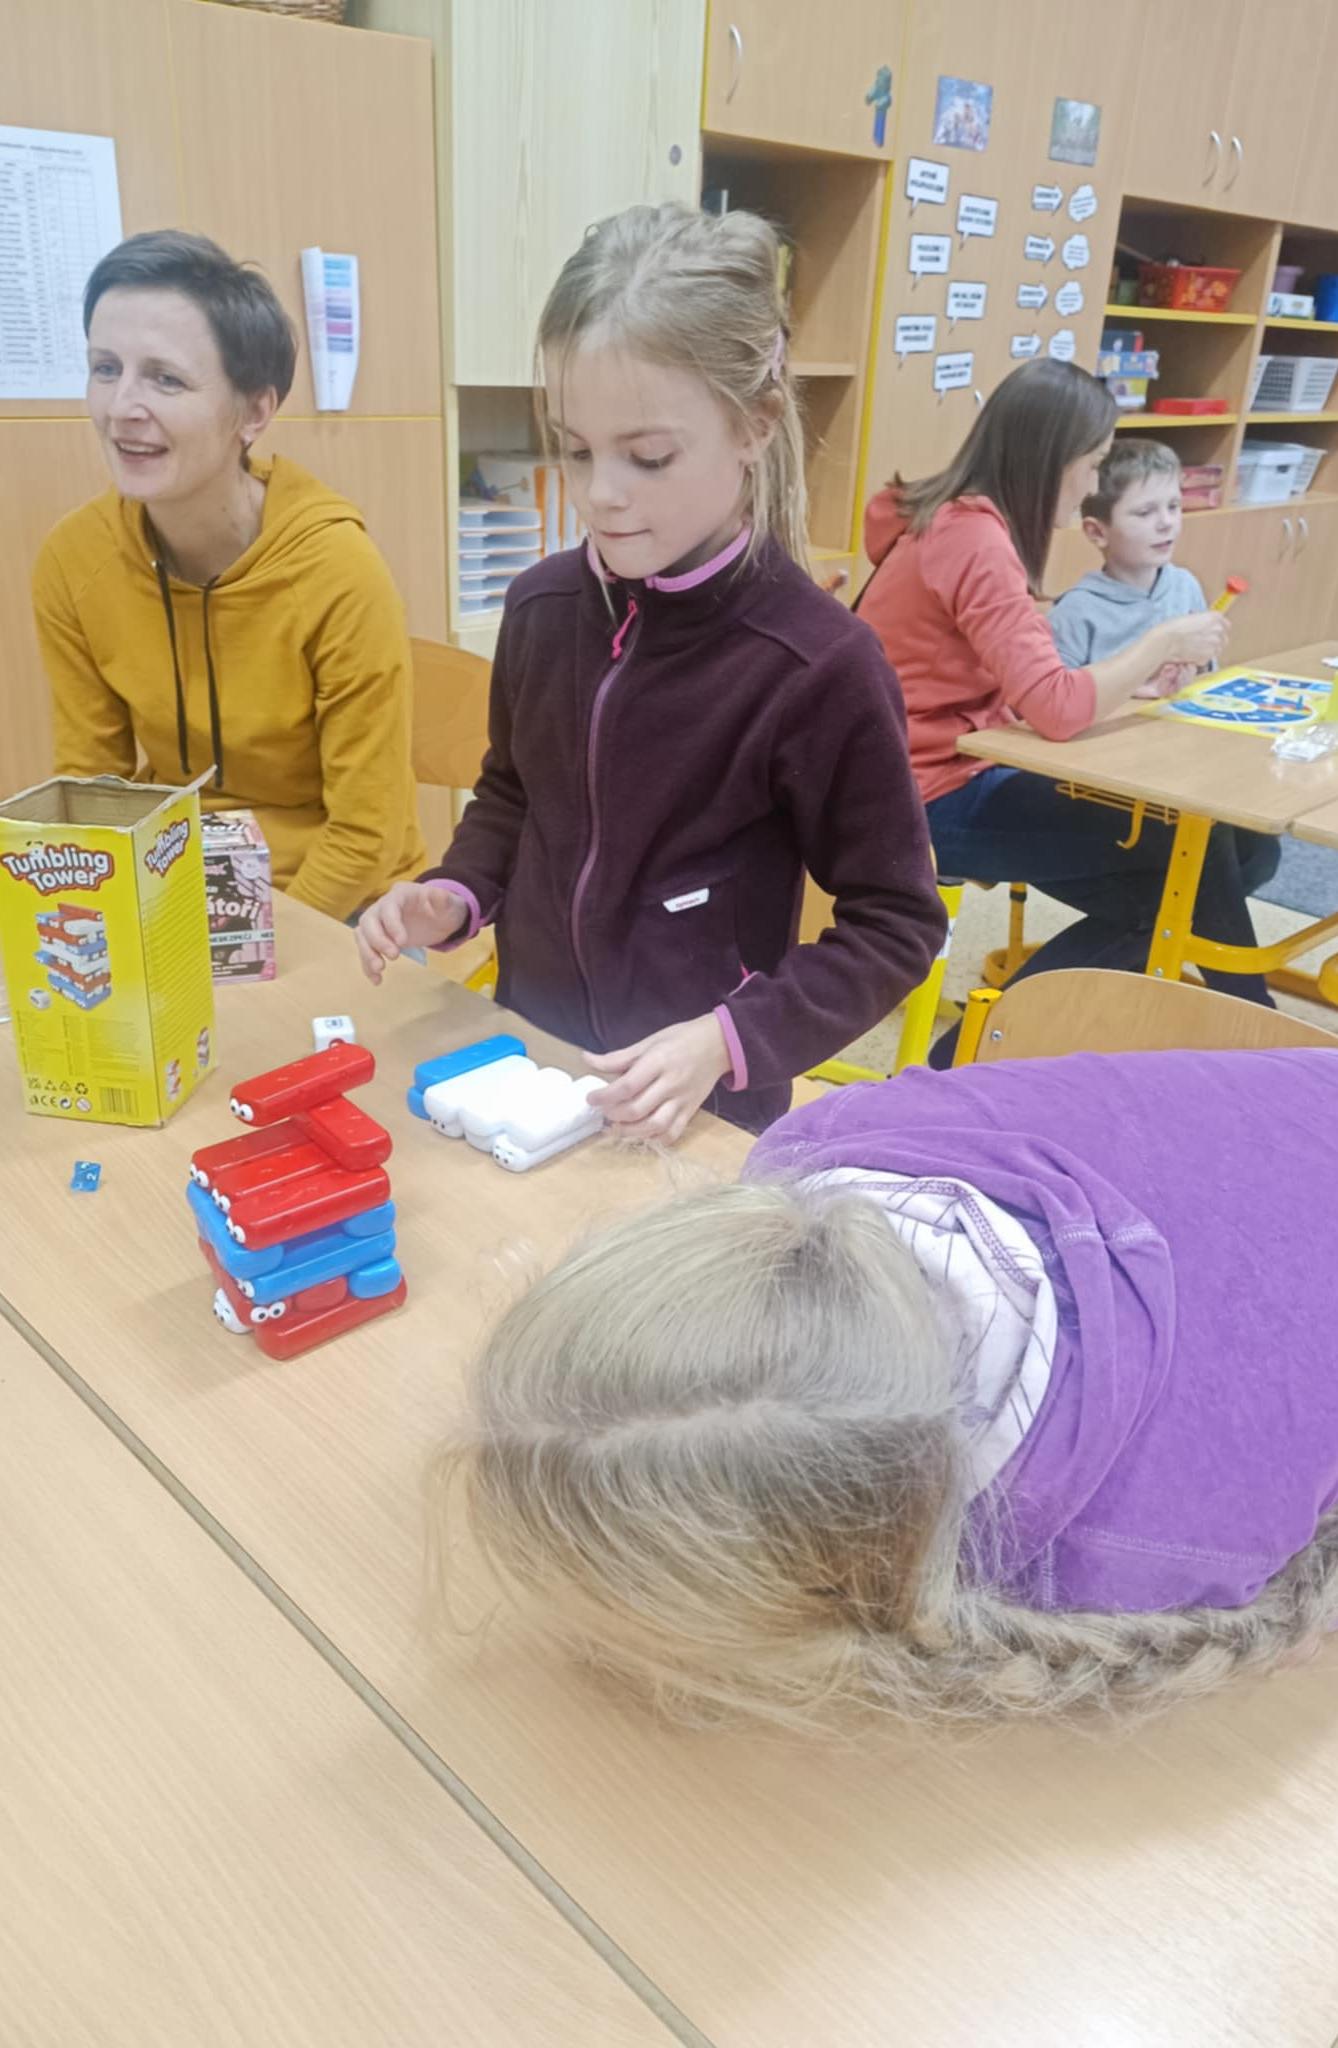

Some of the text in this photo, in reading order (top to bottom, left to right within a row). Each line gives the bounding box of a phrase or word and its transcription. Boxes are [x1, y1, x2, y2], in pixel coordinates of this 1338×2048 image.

[145, 820, 188, 869] Tumbling
[156, 839, 184, 873] Tower
[3, 847, 109, 875] Tumbling
[28, 870, 98, 891] Tower
